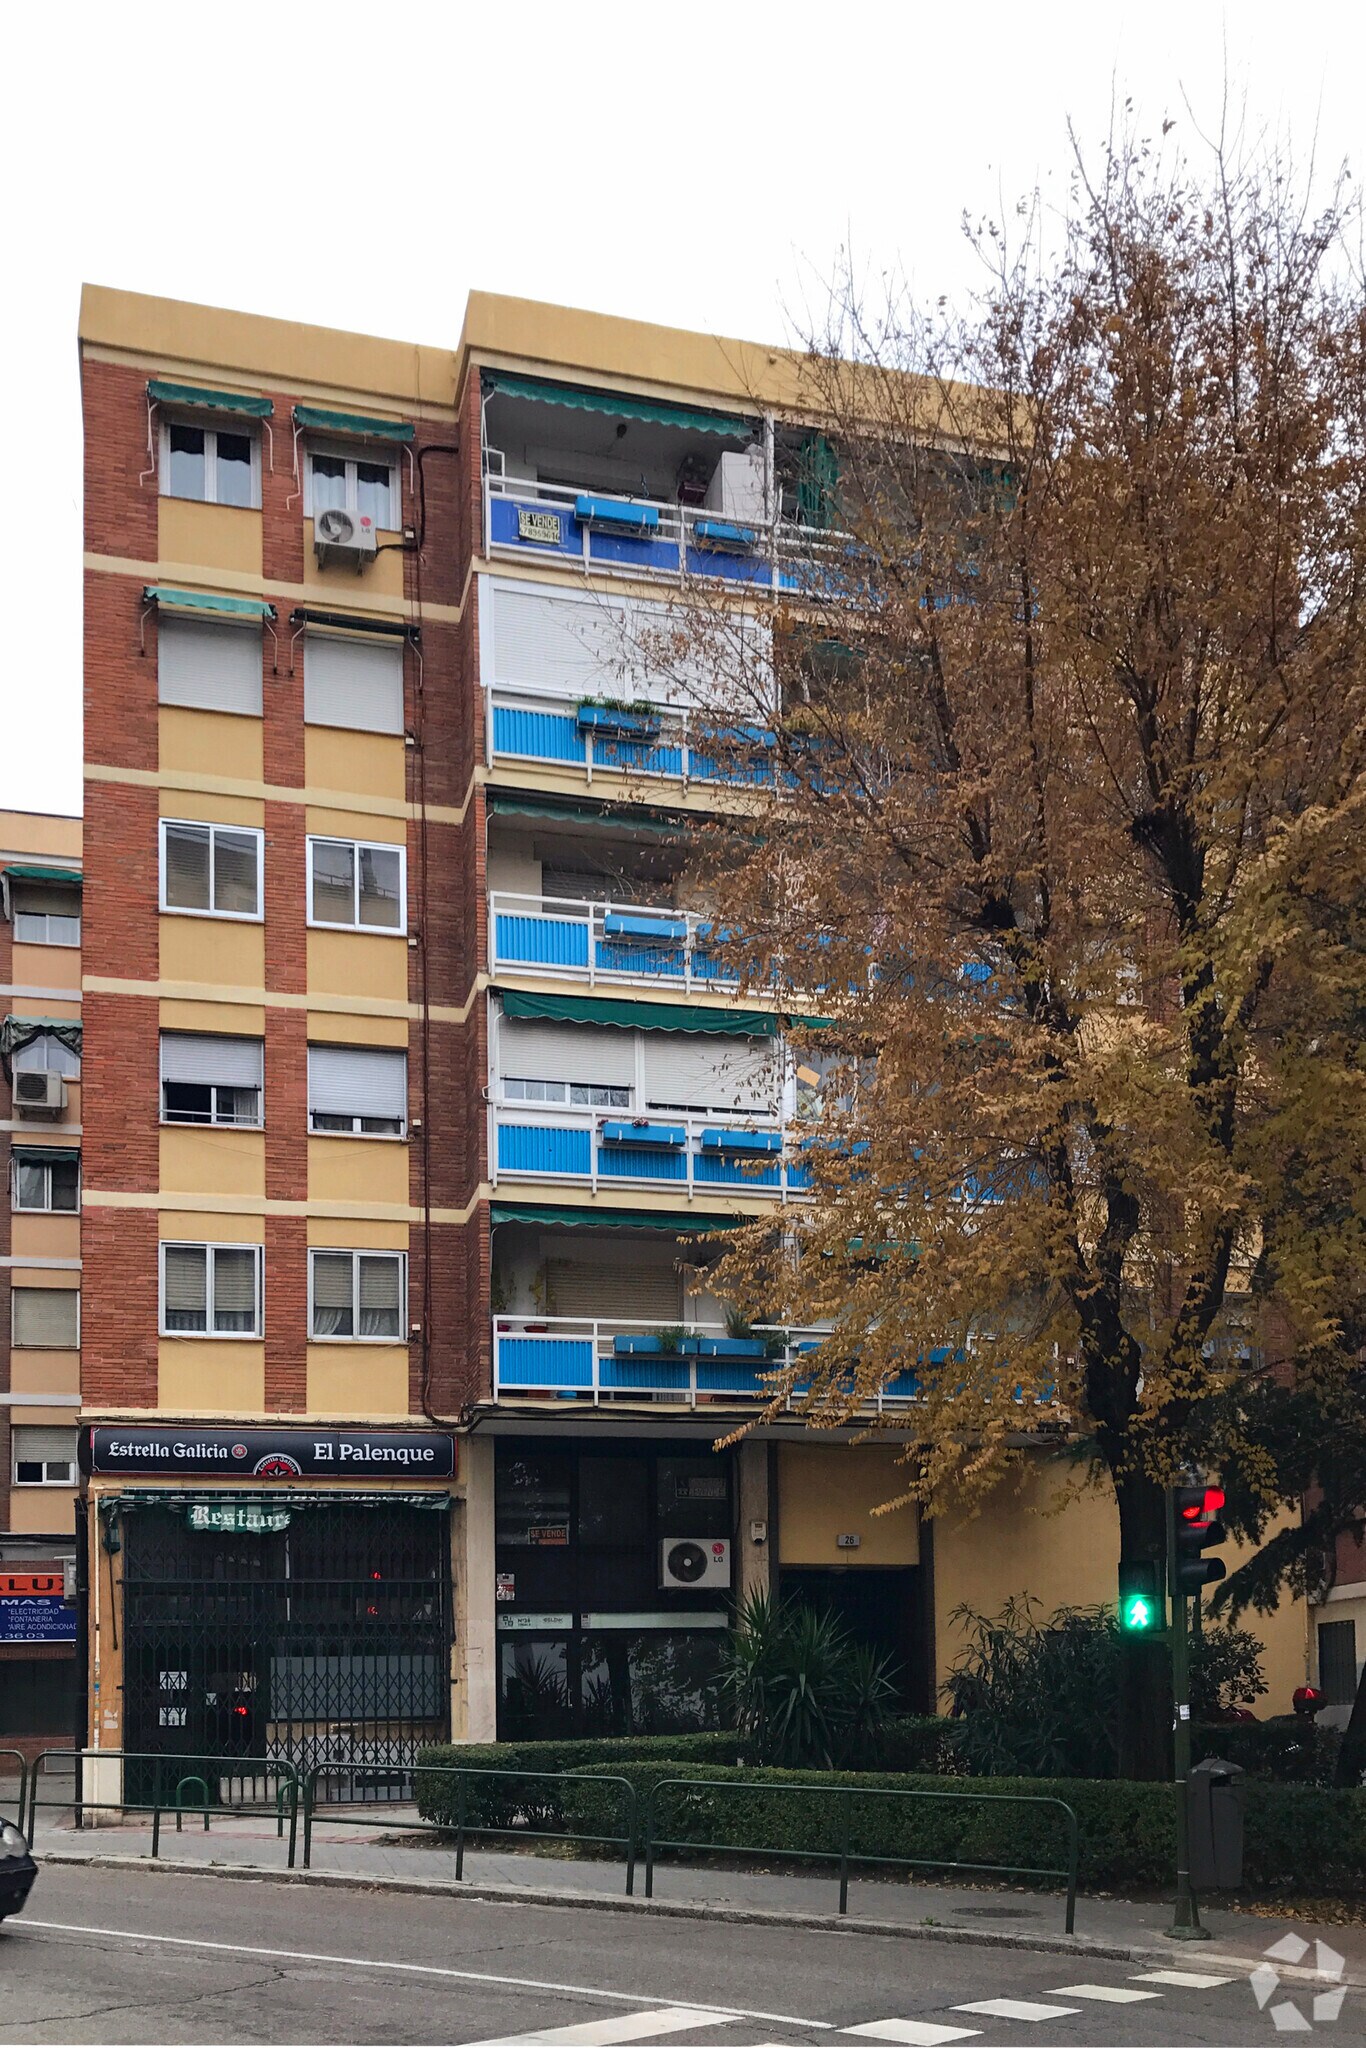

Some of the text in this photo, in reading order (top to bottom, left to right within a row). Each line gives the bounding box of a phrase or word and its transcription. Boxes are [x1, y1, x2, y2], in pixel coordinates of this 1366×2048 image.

[520, 512, 558, 530] SE VENDE
[107, 1441, 434, 1464] Estrella Galicia El Palenque
[530, 1529, 566, 1538] SE VENDE
[844, 1535, 855, 1544] 26
[0, 1578, 65, 1591] LU
